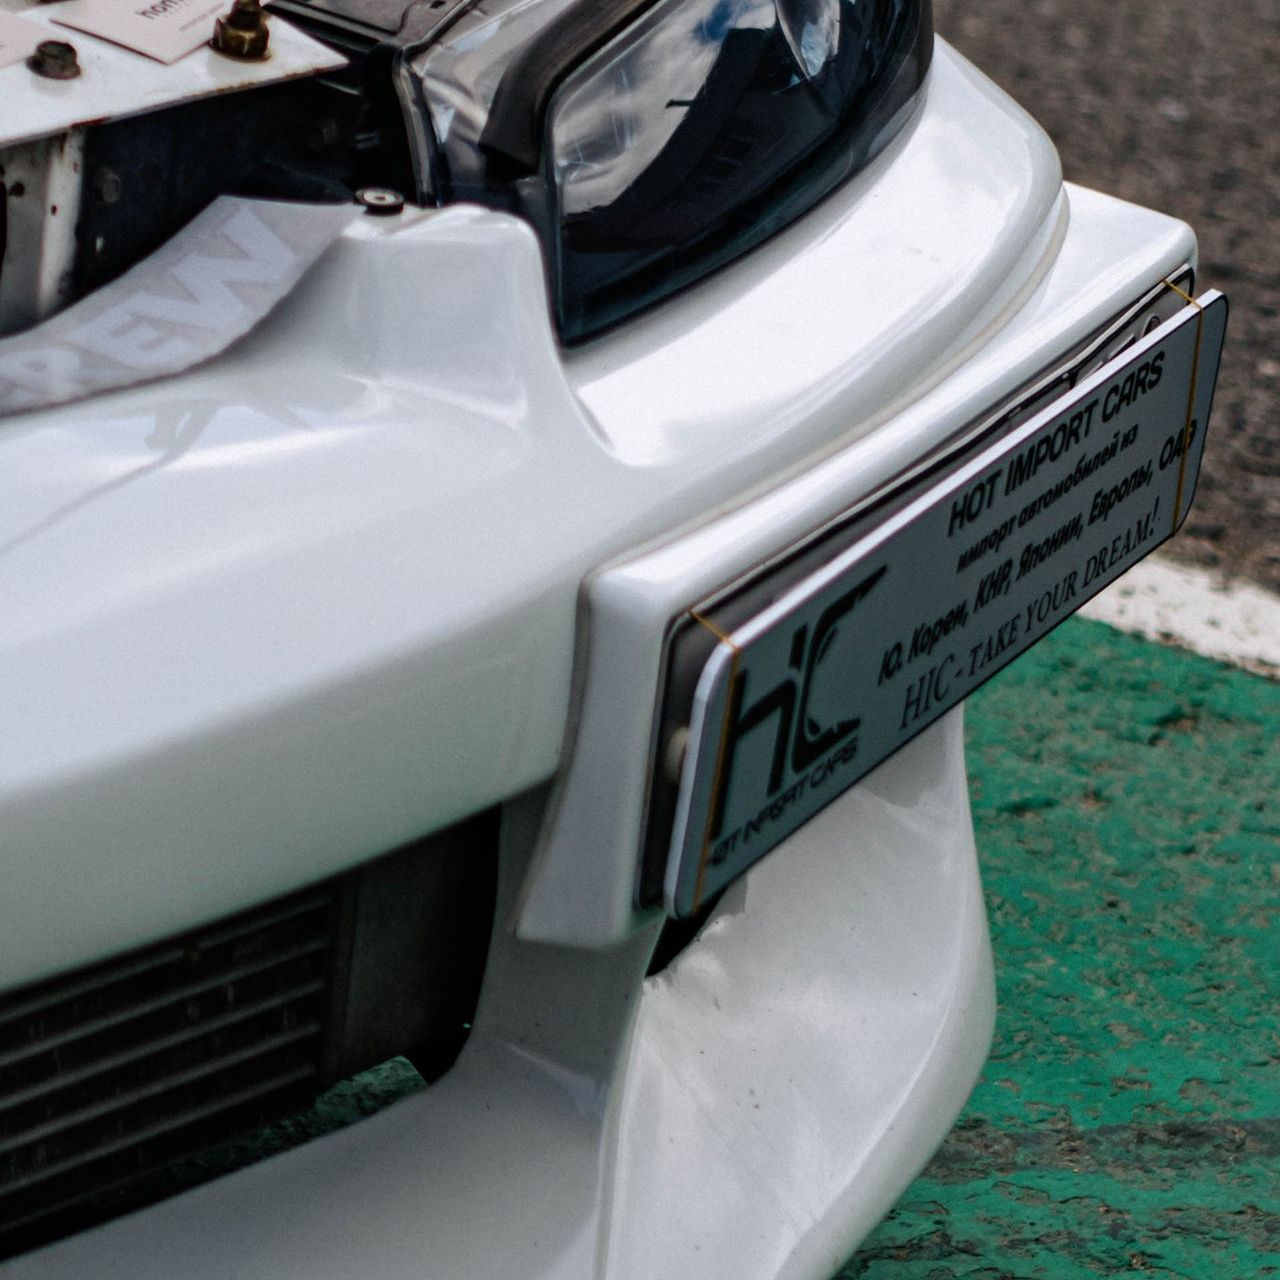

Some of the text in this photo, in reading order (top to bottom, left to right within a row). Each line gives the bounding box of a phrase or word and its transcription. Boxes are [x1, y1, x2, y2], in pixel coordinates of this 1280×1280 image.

[946, 350, 1166, 538] HOT IMPORT CARS
[956, 424, 1139, 574] импорт автомобилей из
[898, 654, 956, 731] HIC
[966, 614, 1021, 678] TAKE
[1024, 570, 1079, 635] YOUR
[1081, 495, 1161, 590] DREAM!
[907, 599, 969, 663] Кореи,
[973, 558, 1014, 613] КНР,
[1016, 512, 1084, 582] Японии,
[1087, 460, 1154, 527] Европы,
